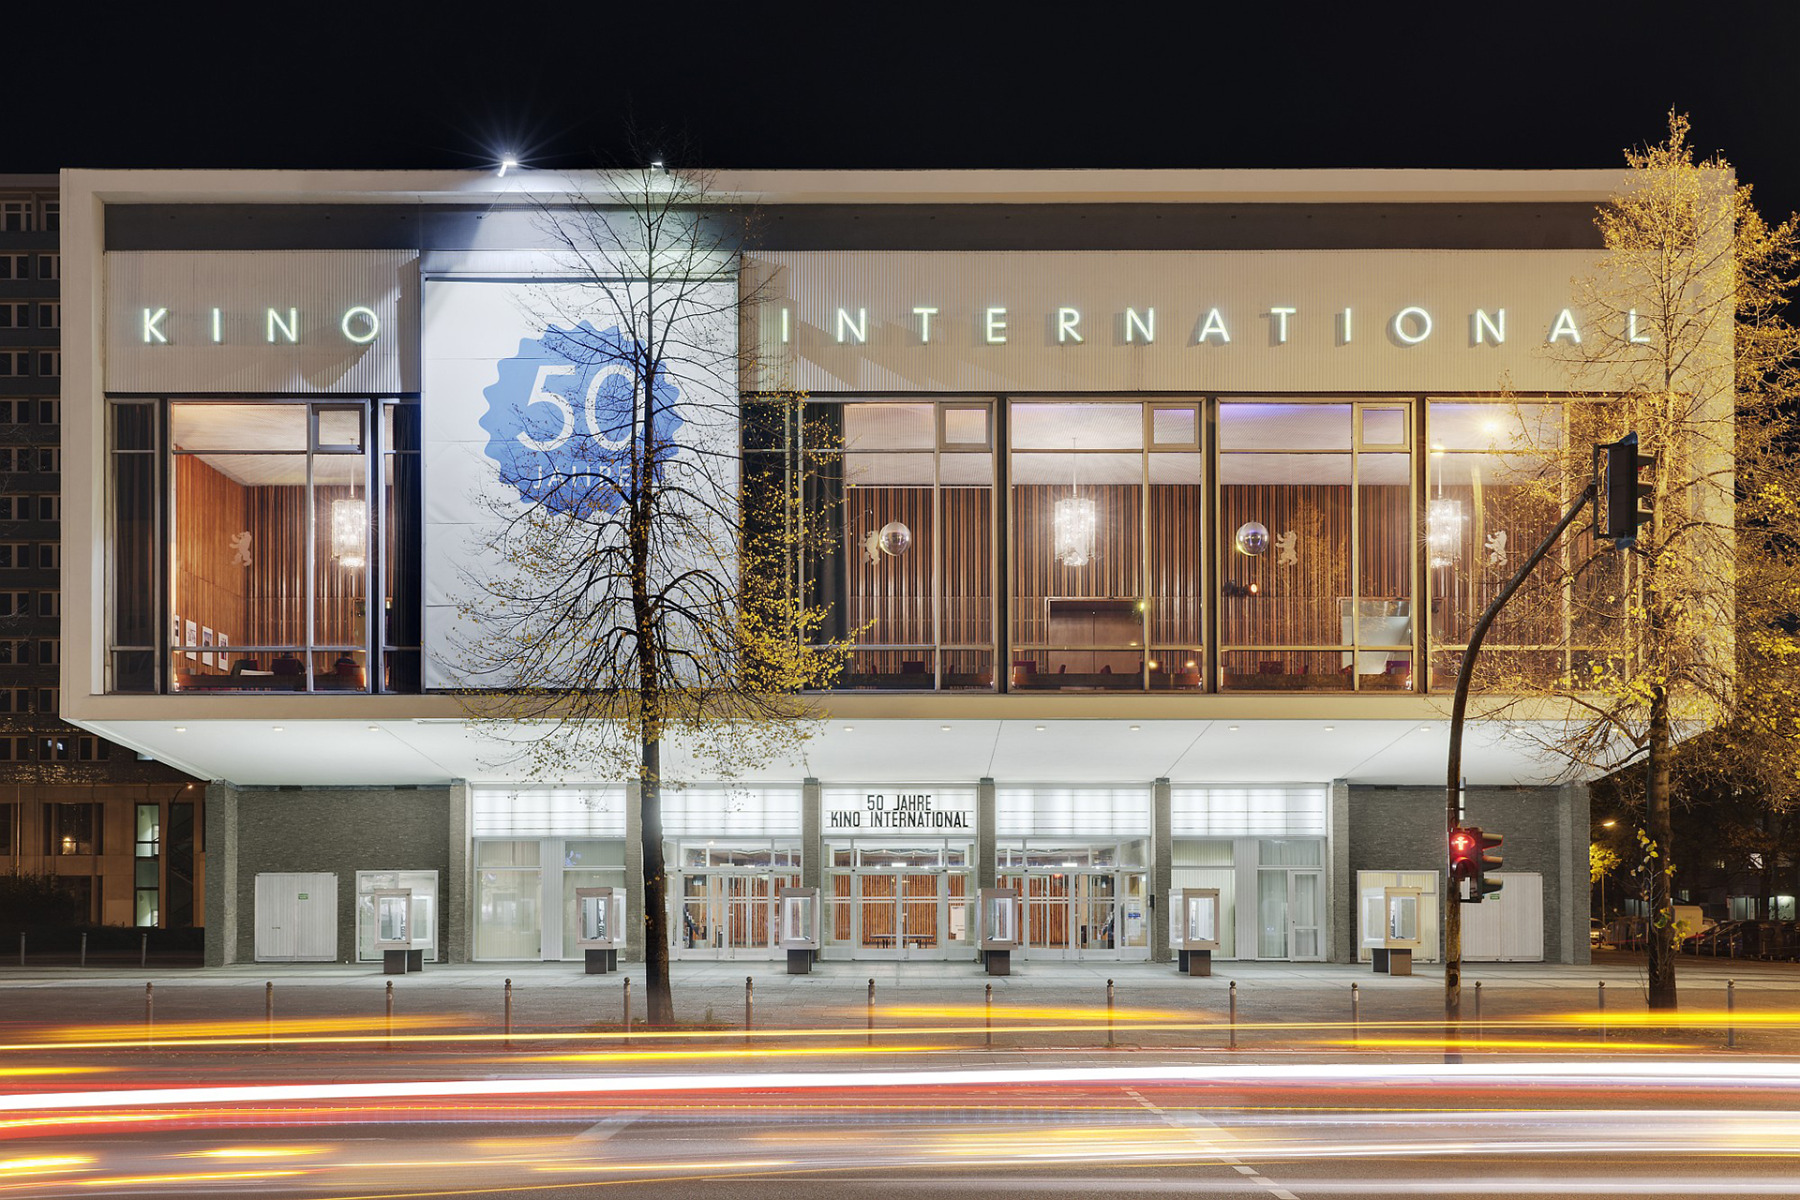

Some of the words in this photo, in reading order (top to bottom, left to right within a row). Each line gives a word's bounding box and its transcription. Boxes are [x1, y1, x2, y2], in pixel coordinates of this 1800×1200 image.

[141, 305, 381, 344] KINO
[780, 305, 1652, 345] INTERNATIONAL
[517, 364, 647, 453] 50
[533, 464, 632, 490] JAHRE
[867, 794, 884, 811] 50
[893, 794, 932, 811] JAHRE
[831, 811, 861, 828] KINO
[870, 811, 969, 828] INTERNATIONAL
